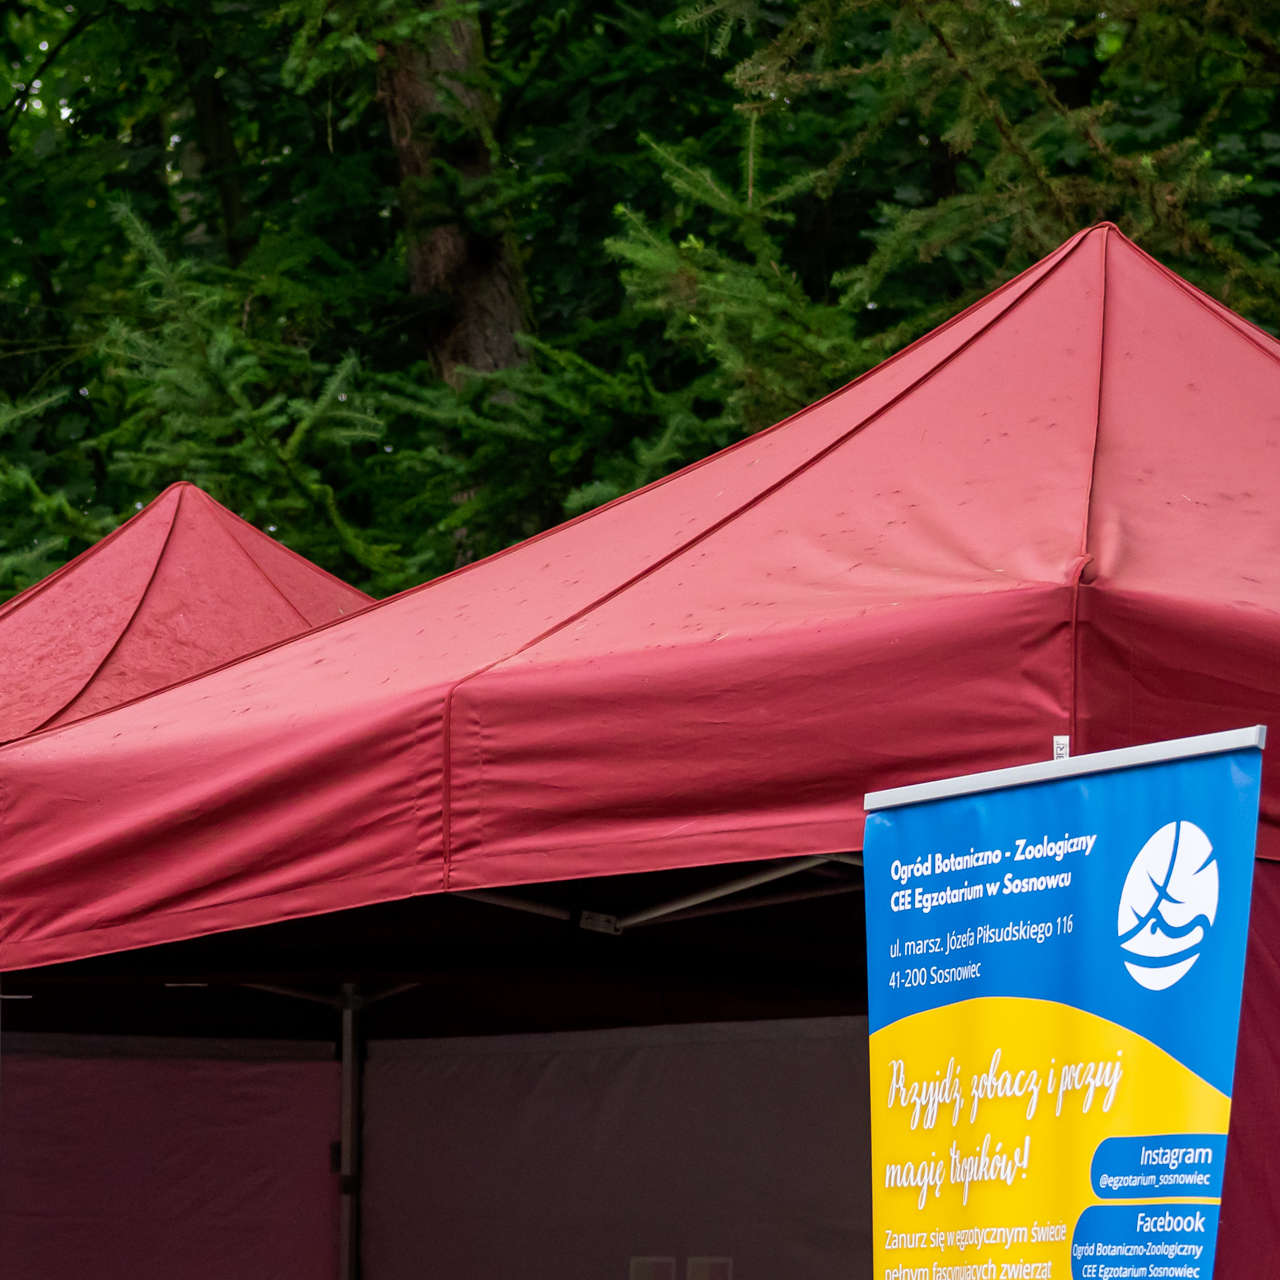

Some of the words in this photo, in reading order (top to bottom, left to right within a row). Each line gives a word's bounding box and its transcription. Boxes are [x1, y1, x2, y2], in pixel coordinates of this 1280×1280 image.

[891, 855, 931, 885] Ogród
[934, 847, 1002, 876] Botaniczno
[1015, 833, 1097, 862] Zoologiczny
[891, 889, 912, 912] CEE
[915, 880, 983, 913] Egzotarium
[986, 881, 999, 897] w
[1002, 872, 1071, 895] Sosnowcu
[890, 938, 902, 958] ul.
[904, 936, 943, 956] marsz.
[946, 927, 975, 955] Józefa
[977, 919, 1053, 949] Piłsudskiego
[1056, 914, 1073, 935] 116
[889, 968, 927, 989] 41-200
[930, 960, 981, 985] Sosnowiec
[887, 1056, 964, 1130] Przyjdź,
[969, 1048, 1042, 1123] zobacz
[1047, 1058, 1056, 1094] i
[1055, 1050, 1123, 1117] poczuj
[885, 1151, 945, 1210] magię
[949, 1133, 1031, 1206] tropików!
[1140, 1146, 1213, 1169] Instagram
[1099, 1171, 1211, 1190] @egzotarium_sosnowiec
[885, 1230, 927, 1250] Zanurz
[930, 1228, 945, 1252] się
[946, 1233, 955, 1246] w
[955, 1226, 1027, 1250] egzotycznym
[1031, 1221, 1067, 1243] świecie
[1136, 1211, 1206, 1233] Facebook
[1072, 1243, 1094, 1260] Ogród
[1096, 1241, 1203, 1260] Botaniczno-Zoologiczny
[1082, 1264, 1097, 1279] CEE
[1098, 1264, 1147, 1280] Egzotarium
[1148, 1264, 1200, 1279] Sosnowiec
